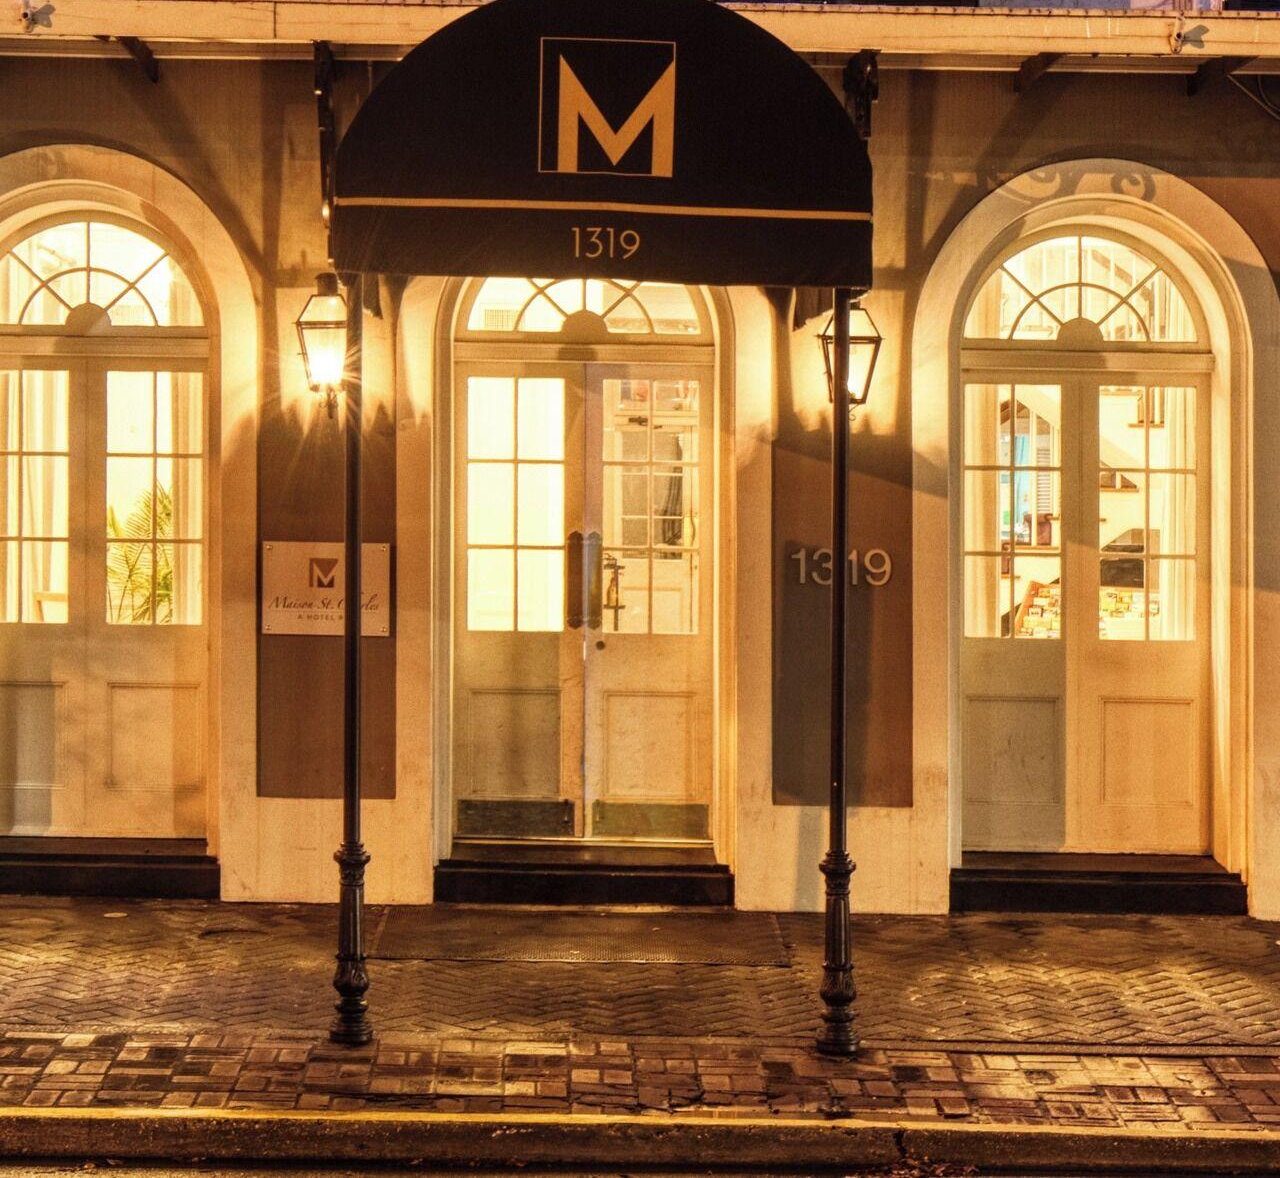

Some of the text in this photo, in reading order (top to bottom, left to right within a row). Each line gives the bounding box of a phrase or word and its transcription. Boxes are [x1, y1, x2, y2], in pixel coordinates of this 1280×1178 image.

[557, 53, 677, 178] M
[571, 226, 641, 260] 1319
[791, 548, 892, 586] 1319
[268, 596, 314, 610] Maison
